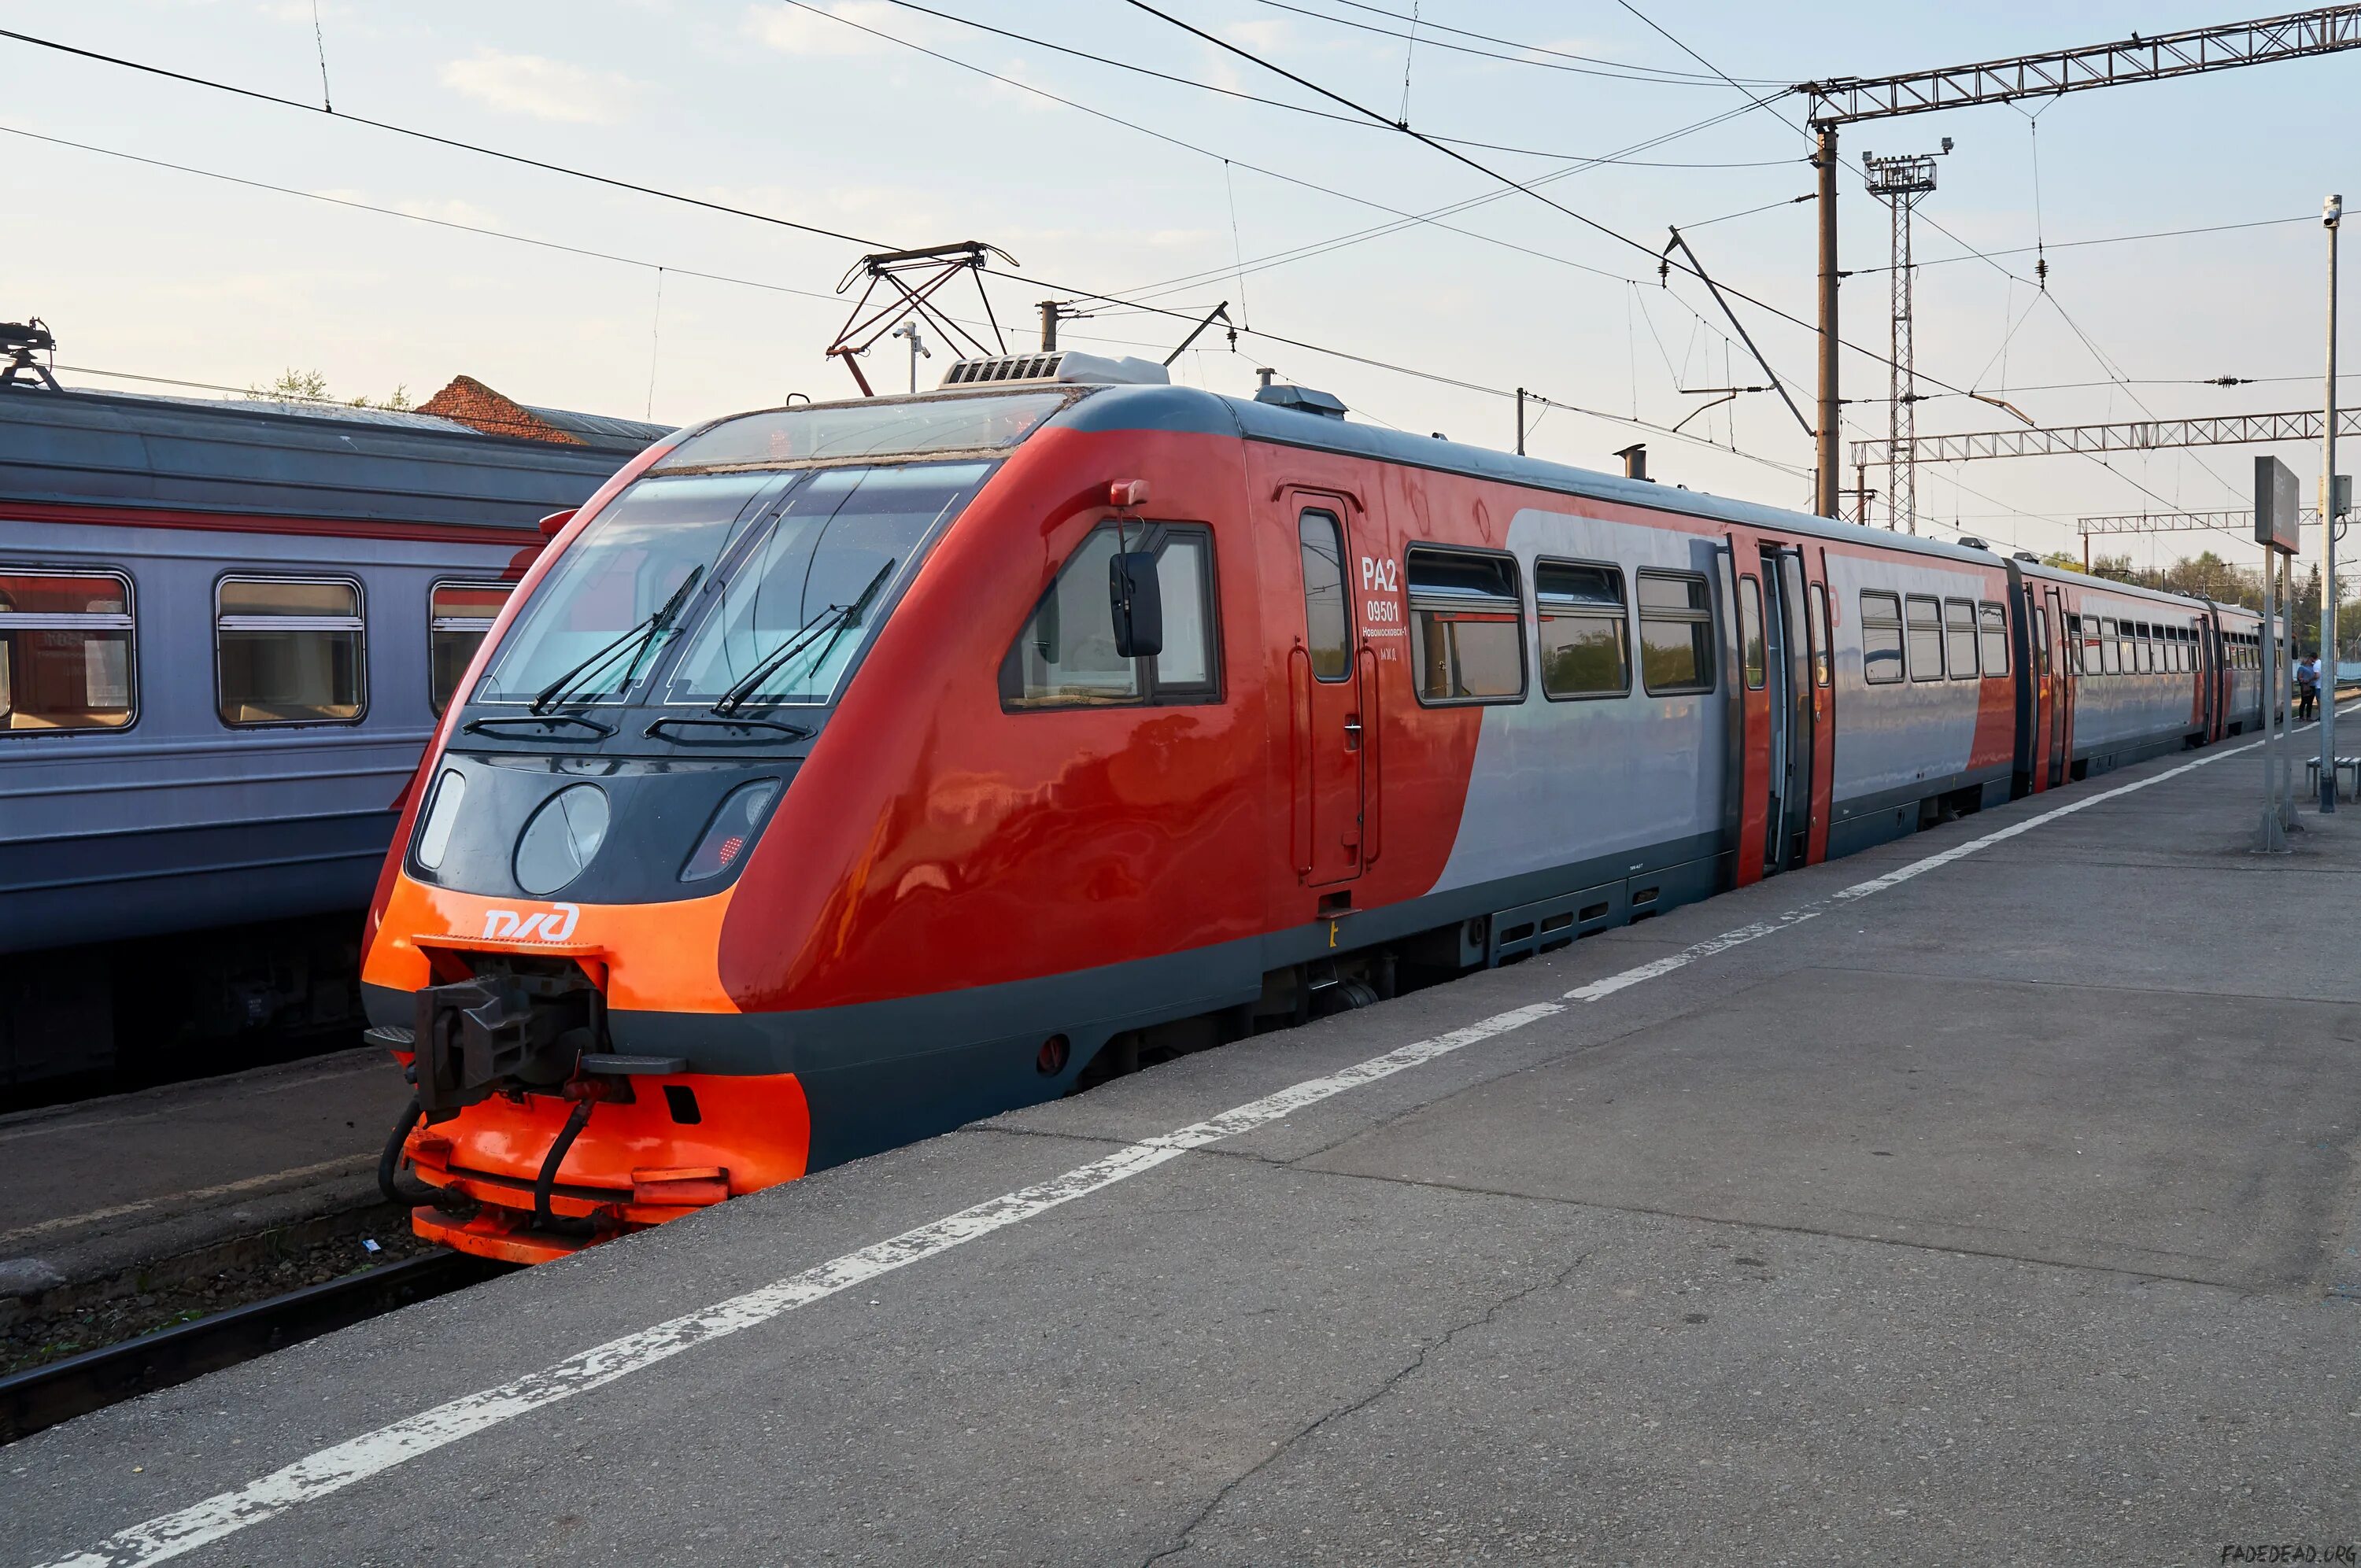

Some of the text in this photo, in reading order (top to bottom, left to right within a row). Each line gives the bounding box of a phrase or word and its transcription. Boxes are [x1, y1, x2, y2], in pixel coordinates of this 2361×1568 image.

[1362, 557, 1398, 592] РА2
[1367, 600, 1398, 622] 09501
[1362, 626, 1407, 637] Новомосковск-1
